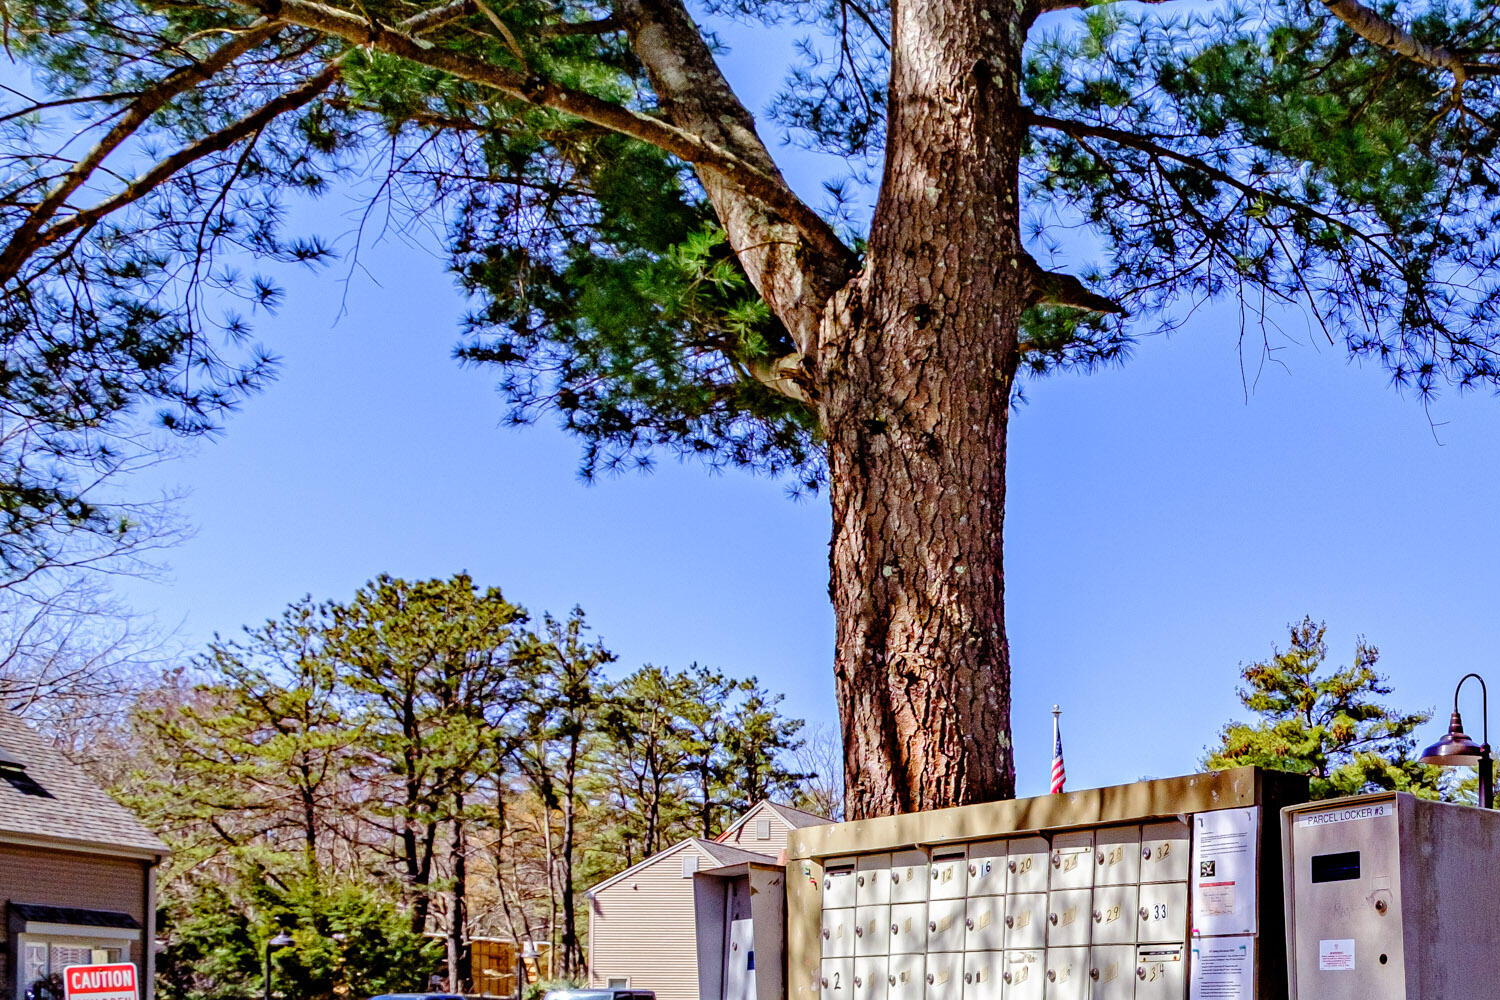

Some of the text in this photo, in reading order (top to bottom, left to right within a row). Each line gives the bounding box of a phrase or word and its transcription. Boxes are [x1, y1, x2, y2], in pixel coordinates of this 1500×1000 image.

[1307, 806, 1384, 825] PARCEL LOCKER #3
[1157, 843, 1170, 859] 32
[981, 860, 991, 877] 16
[1020, 857, 1032, 874] 20
[942, 868, 953, 883] 12
[1106, 906, 1119, 922] 29
[1154, 903, 1167, 920] 33
[71, 969, 133, 990] CAUTION
[833, 972, 842, 990] 2
